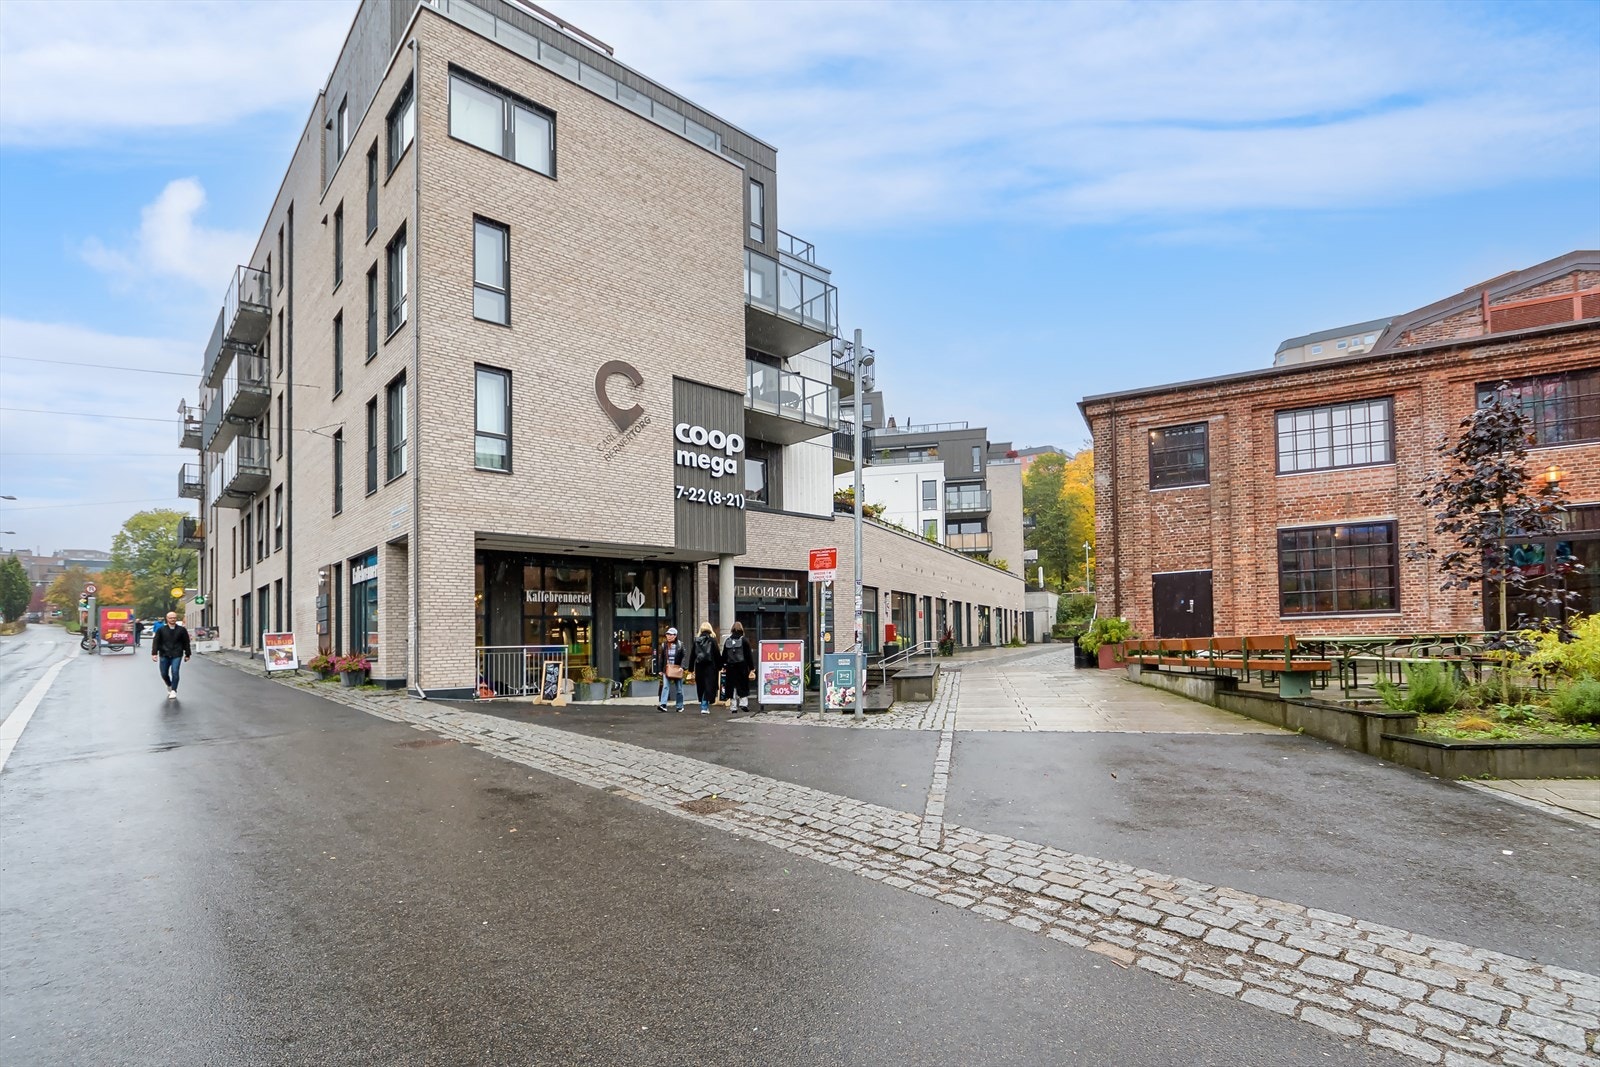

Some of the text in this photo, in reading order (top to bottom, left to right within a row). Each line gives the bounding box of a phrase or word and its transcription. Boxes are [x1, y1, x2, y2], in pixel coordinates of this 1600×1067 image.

[597, 433, 617, 452] CARL
[603, 416, 652, 462] BERNERTORG
[675, 423, 745, 456] coop
[677, 450, 738, 478] mega
[676, 485, 745, 510] 7-22 (8-21)
[526, 590, 592, 603] Kaffebrenneriet
[266, 638, 293, 646] TILBUD
[767, 652, 796, 661] KUPP
[772, 687, 791, 695] -40%
